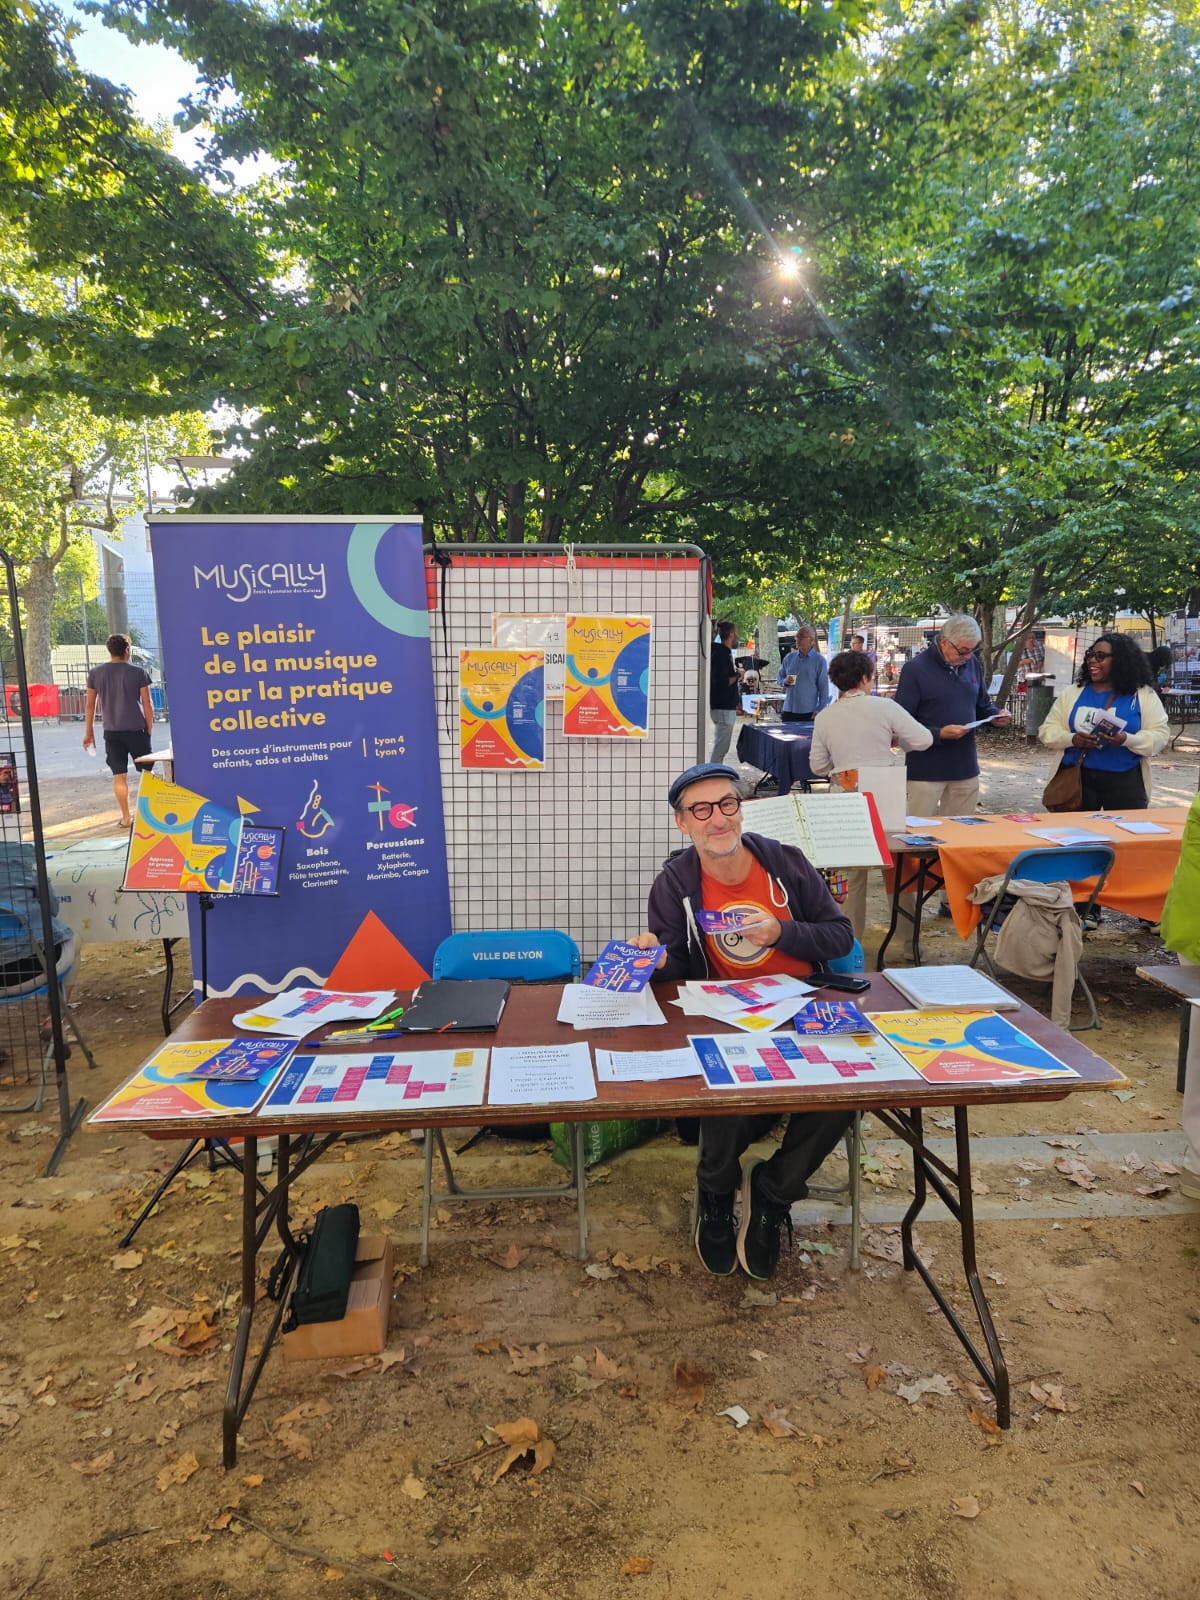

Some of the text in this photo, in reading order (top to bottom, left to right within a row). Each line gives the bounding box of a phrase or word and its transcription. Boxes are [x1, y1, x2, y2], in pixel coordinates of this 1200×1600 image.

[201, 622, 316, 650] Le plaisir
[204, 650, 378, 675] de la musique
[207, 677, 393, 709] par la pratique
[209, 707, 326, 732] collective
[374, 736, 404, 746] Lyon 4
[212, 740, 352, 758] Des cours d'instruments pour
[375, 746, 405, 758] Lyon 9
[212, 753, 328, 768] enfants, ados et adultes
[366, 838, 425, 850] Percussions
[306, 846, 328, 856] Bois
[382, 852, 411, 860] Batterie,
[296, 861, 341, 870] Saxophone,
[377, 861, 417, 871] Xylophone,
[367, 869, 429, 881] Marimba, Congas
[302, 879, 338, 888] Clarinette
[472, 950, 543, 960] VILLE DE LYON
